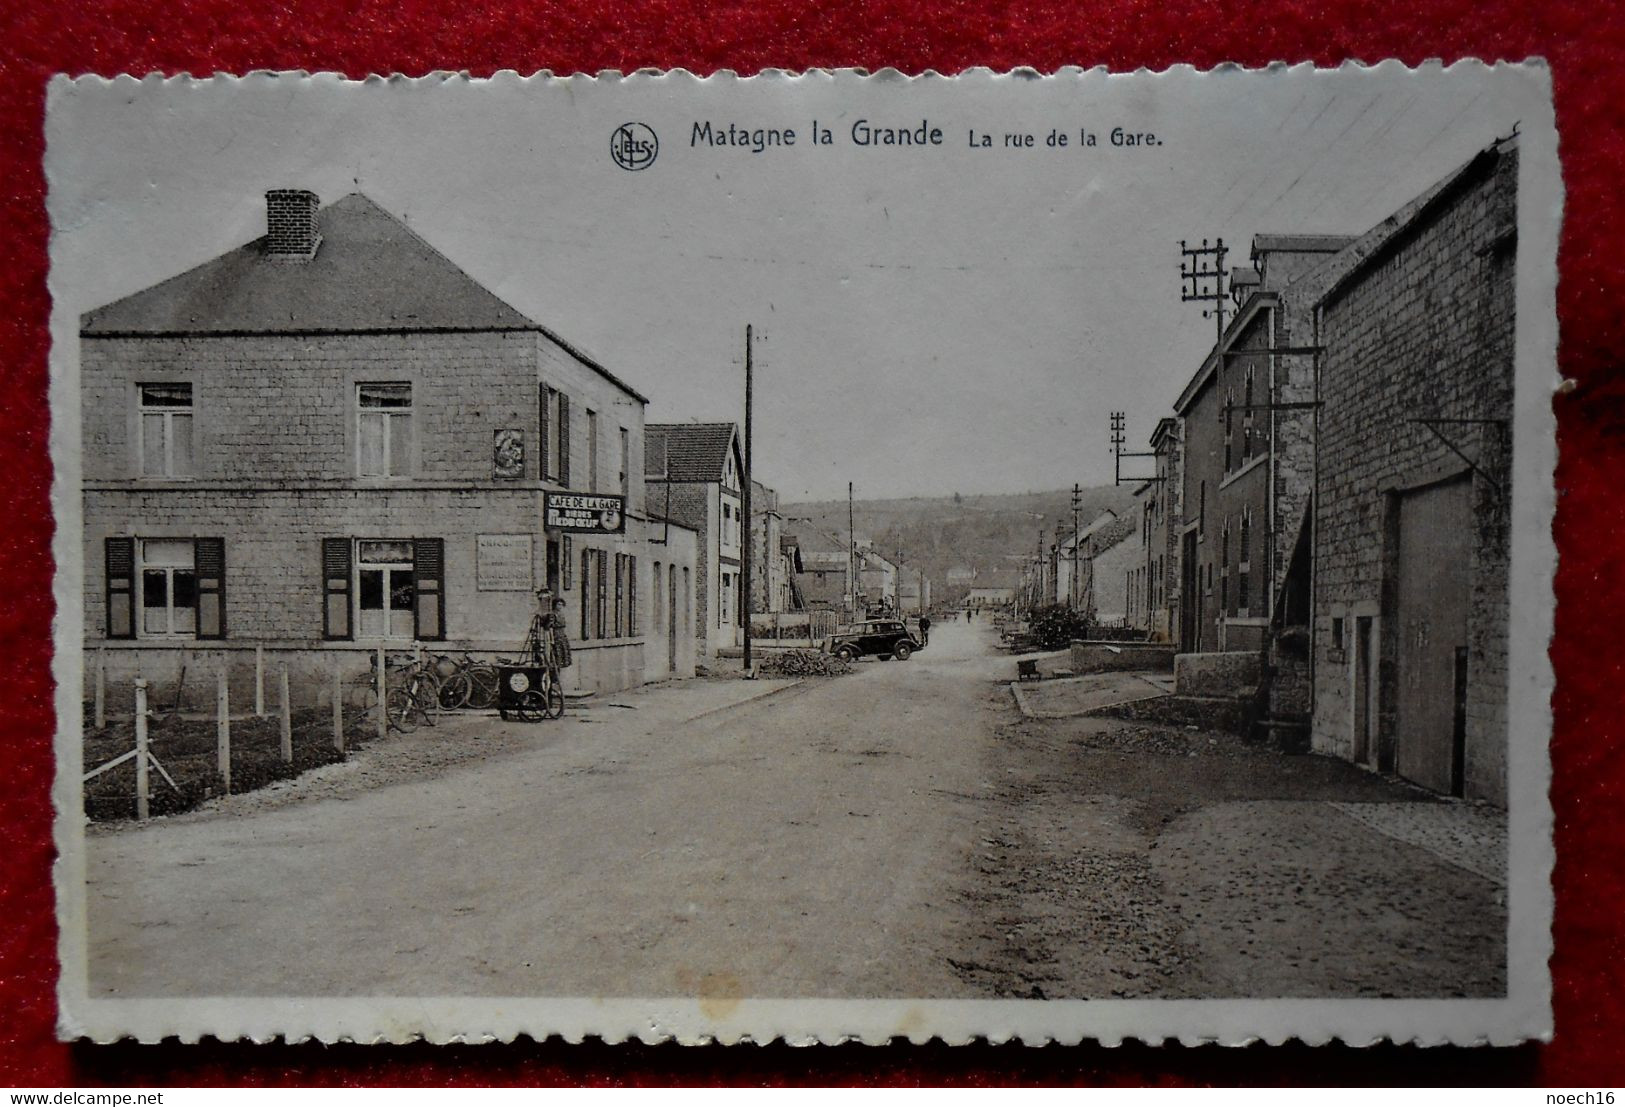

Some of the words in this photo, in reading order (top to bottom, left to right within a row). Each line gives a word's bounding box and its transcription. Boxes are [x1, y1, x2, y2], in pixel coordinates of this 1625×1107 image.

[690, 121, 796, 152] Matagne
[812, 120, 833, 146] la
[852, 119, 943, 146] Grande
[969, 129, 993, 148] La
[1004, 133, 1035, 148] rue
[1046, 129, 1069, 148] de
[1080, 128, 1097, 147] la
[1110, 127, 1164, 147] Gare.
[548, 495, 571, 508] CAFE
[573, 497, 584, 508] DE
[587, 498, 597, 509] LA
[600, 499, 620, 510] GARE
